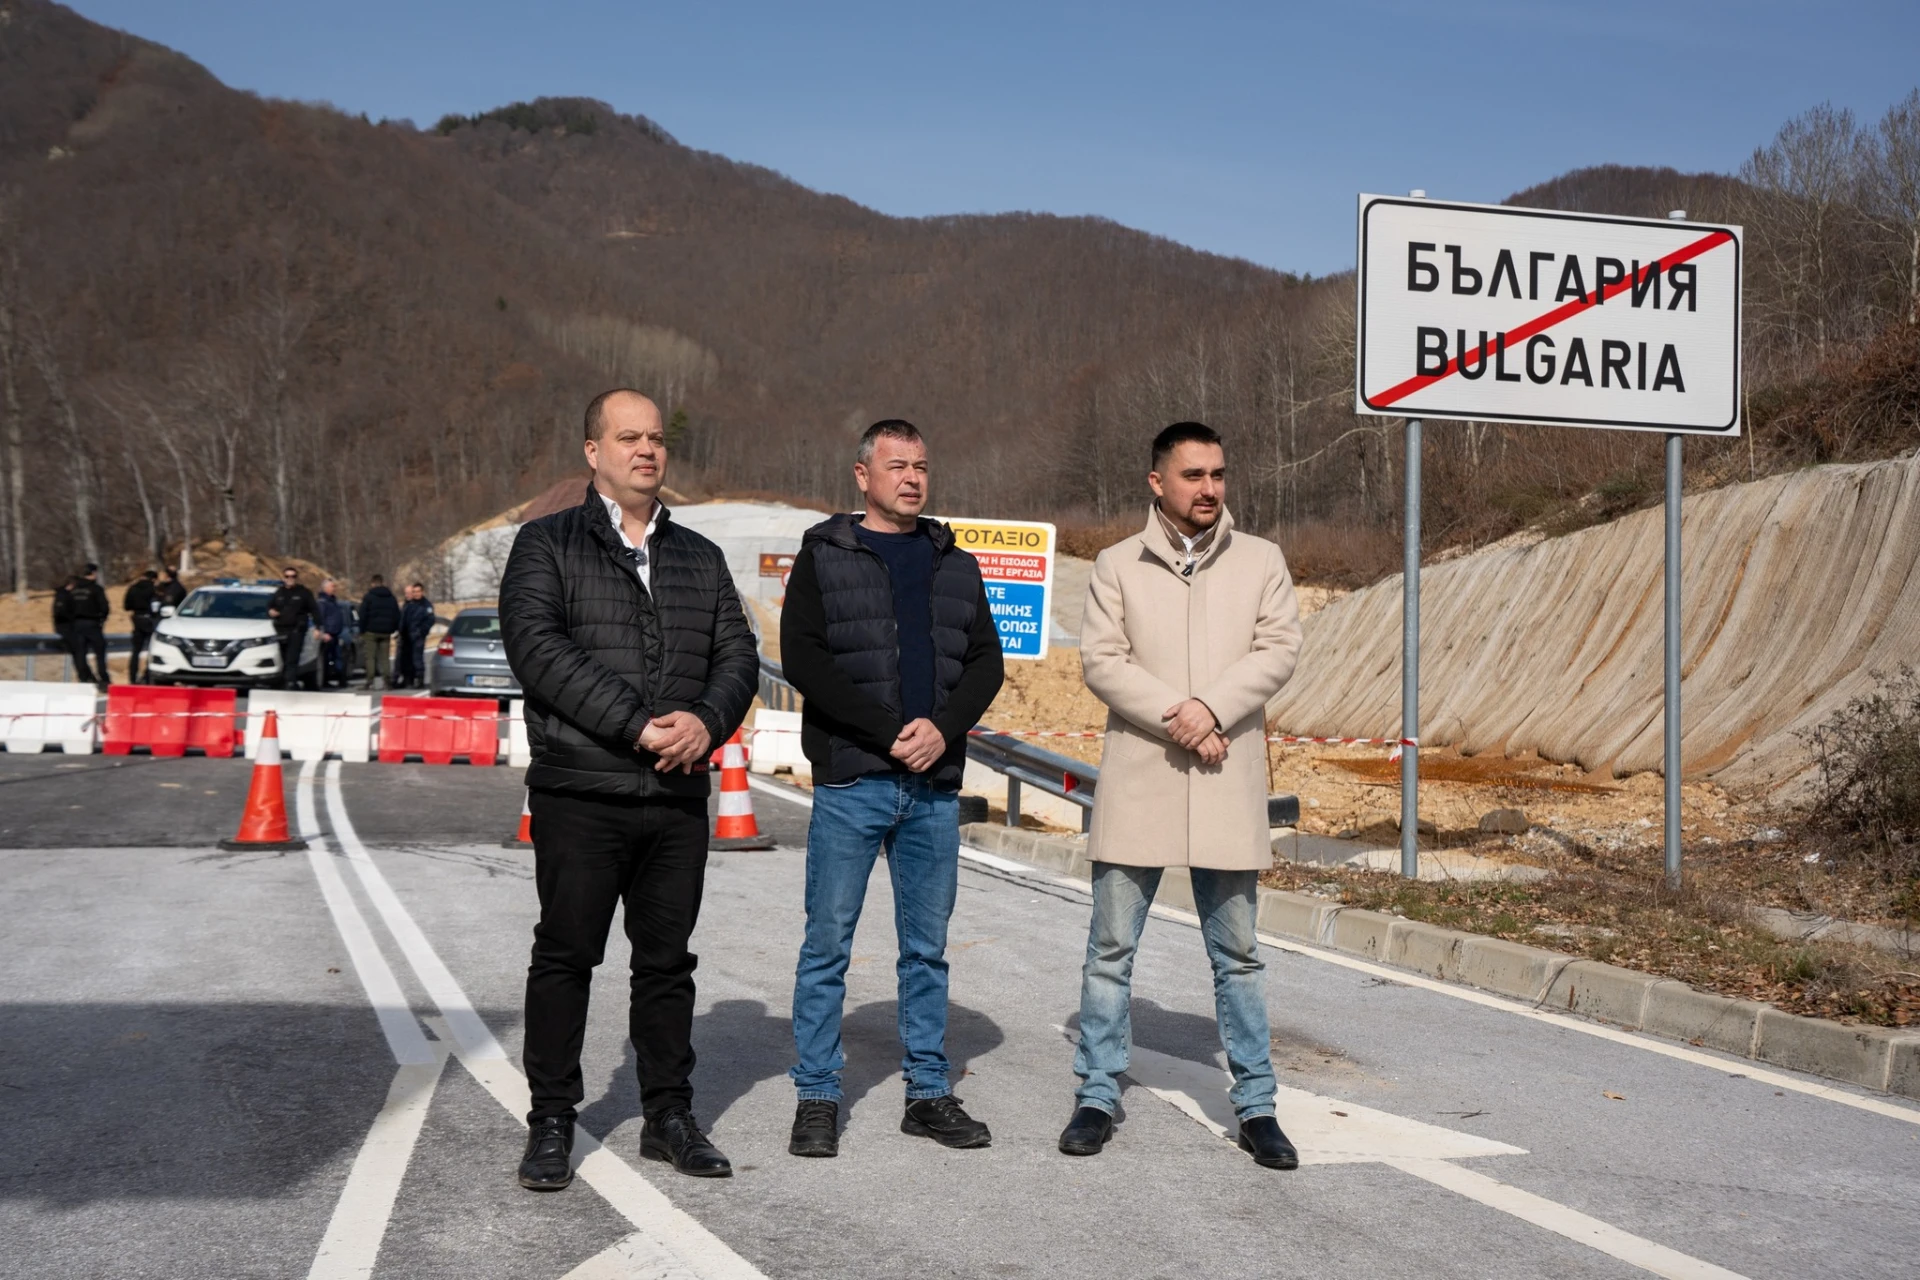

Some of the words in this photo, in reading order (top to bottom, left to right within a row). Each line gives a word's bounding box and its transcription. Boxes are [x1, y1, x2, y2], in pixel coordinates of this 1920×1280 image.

[1407, 241, 1697, 312] БЪЛГАРИЯ
[1416, 326, 1686, 393] BULGARIA
[1000, 558, 1039, 567] ΕΙΣΟΔΟΣ
[1006, 569, 1043, 578] ΕΡΓΑΣΙΑ
[999, 620, 1038, 634] ΟΠΩΣ
